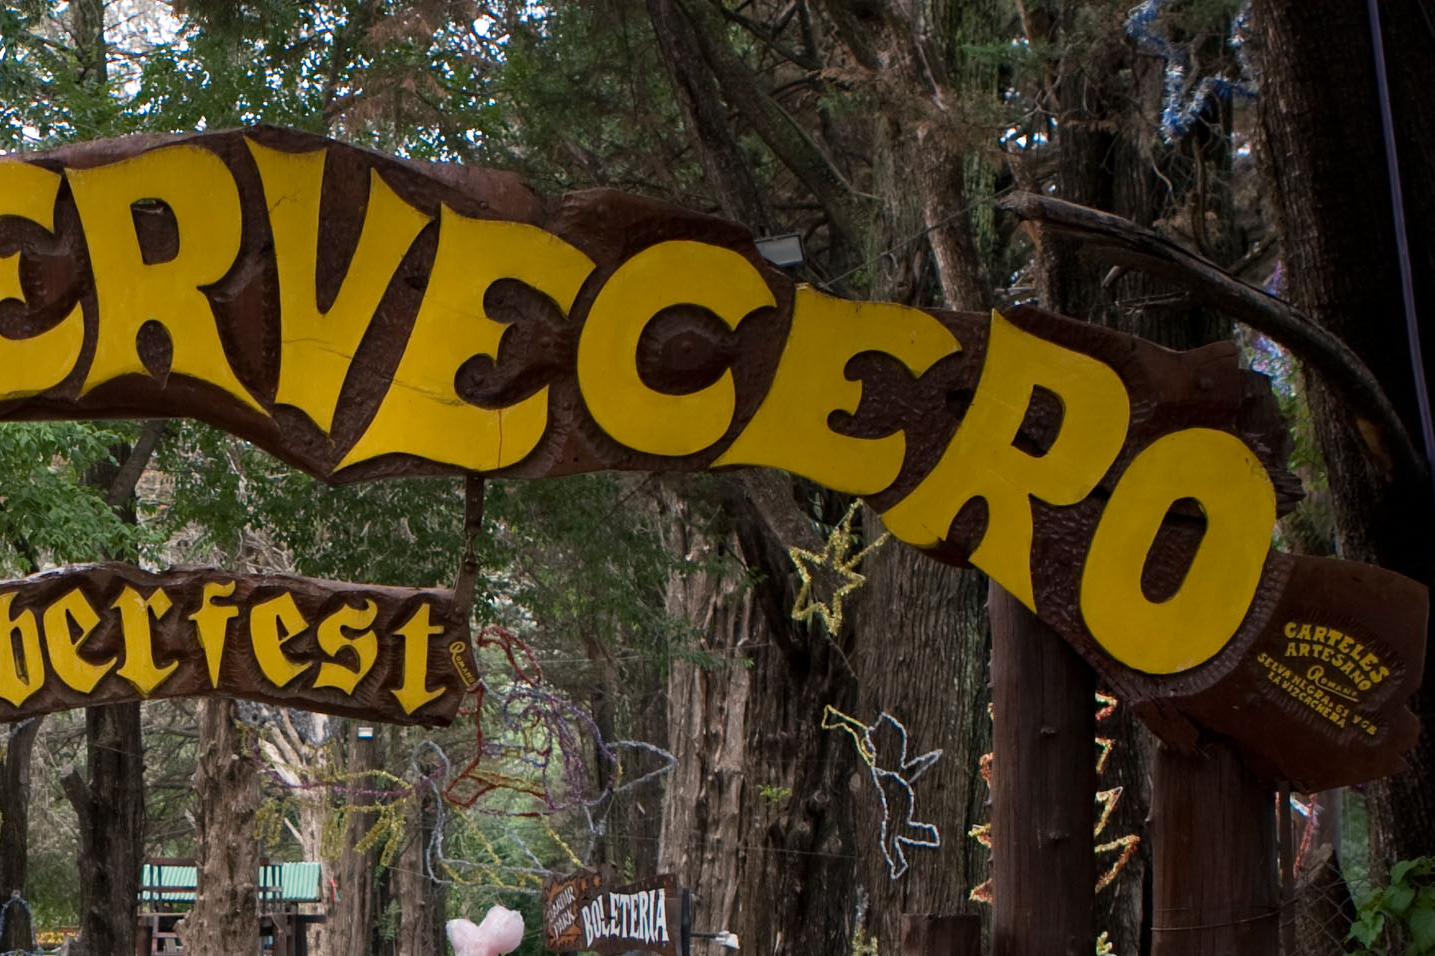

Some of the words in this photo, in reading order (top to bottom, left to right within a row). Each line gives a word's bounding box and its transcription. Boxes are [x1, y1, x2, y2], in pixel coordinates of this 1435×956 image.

[1257, 653, 1292, 680] SELVA
[1284, 622, 1389, 683] CARTELES
[1285, 642, 1372, 691] ARTESANO
[1267, 671, 1280, 686] LA
[581, 888, 670, 948] BOLETERIA
